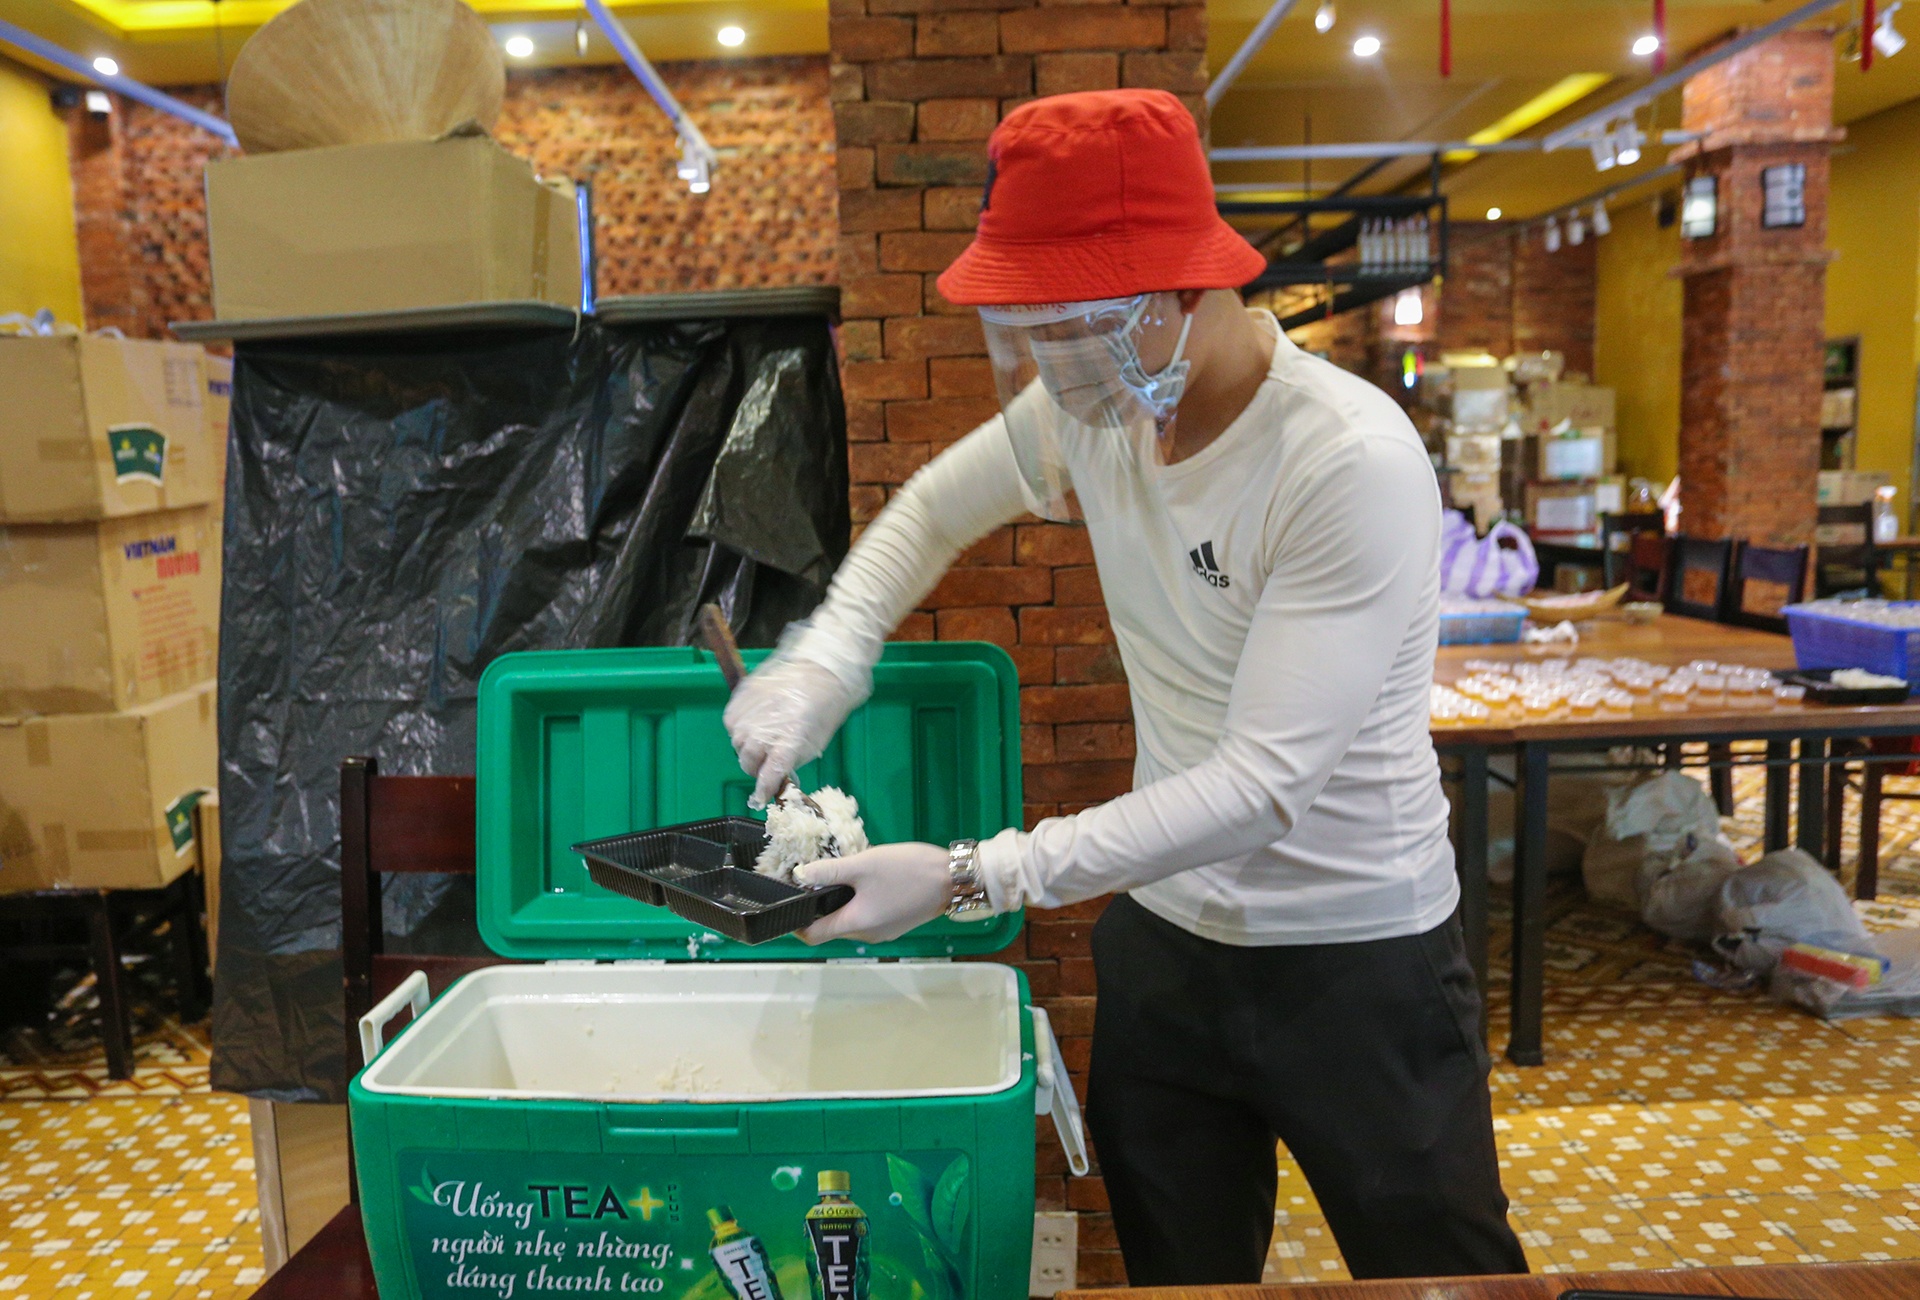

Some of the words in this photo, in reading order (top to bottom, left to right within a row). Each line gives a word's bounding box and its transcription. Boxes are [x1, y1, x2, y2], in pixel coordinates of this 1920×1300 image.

[433, 1180, 534, 1230] Uống
[819, 1223, 852, 1231] SUNTORY
[431, 1229, 505, 1265] người
[514, 1229, 567, 1263] nhẹ
[446, 1264, 517, 1299] dáng
[526, 1264, 613, 1292] thanh
[620, 1271, 665, 1293] tao
[822, 1235, 850, 1300] TE
